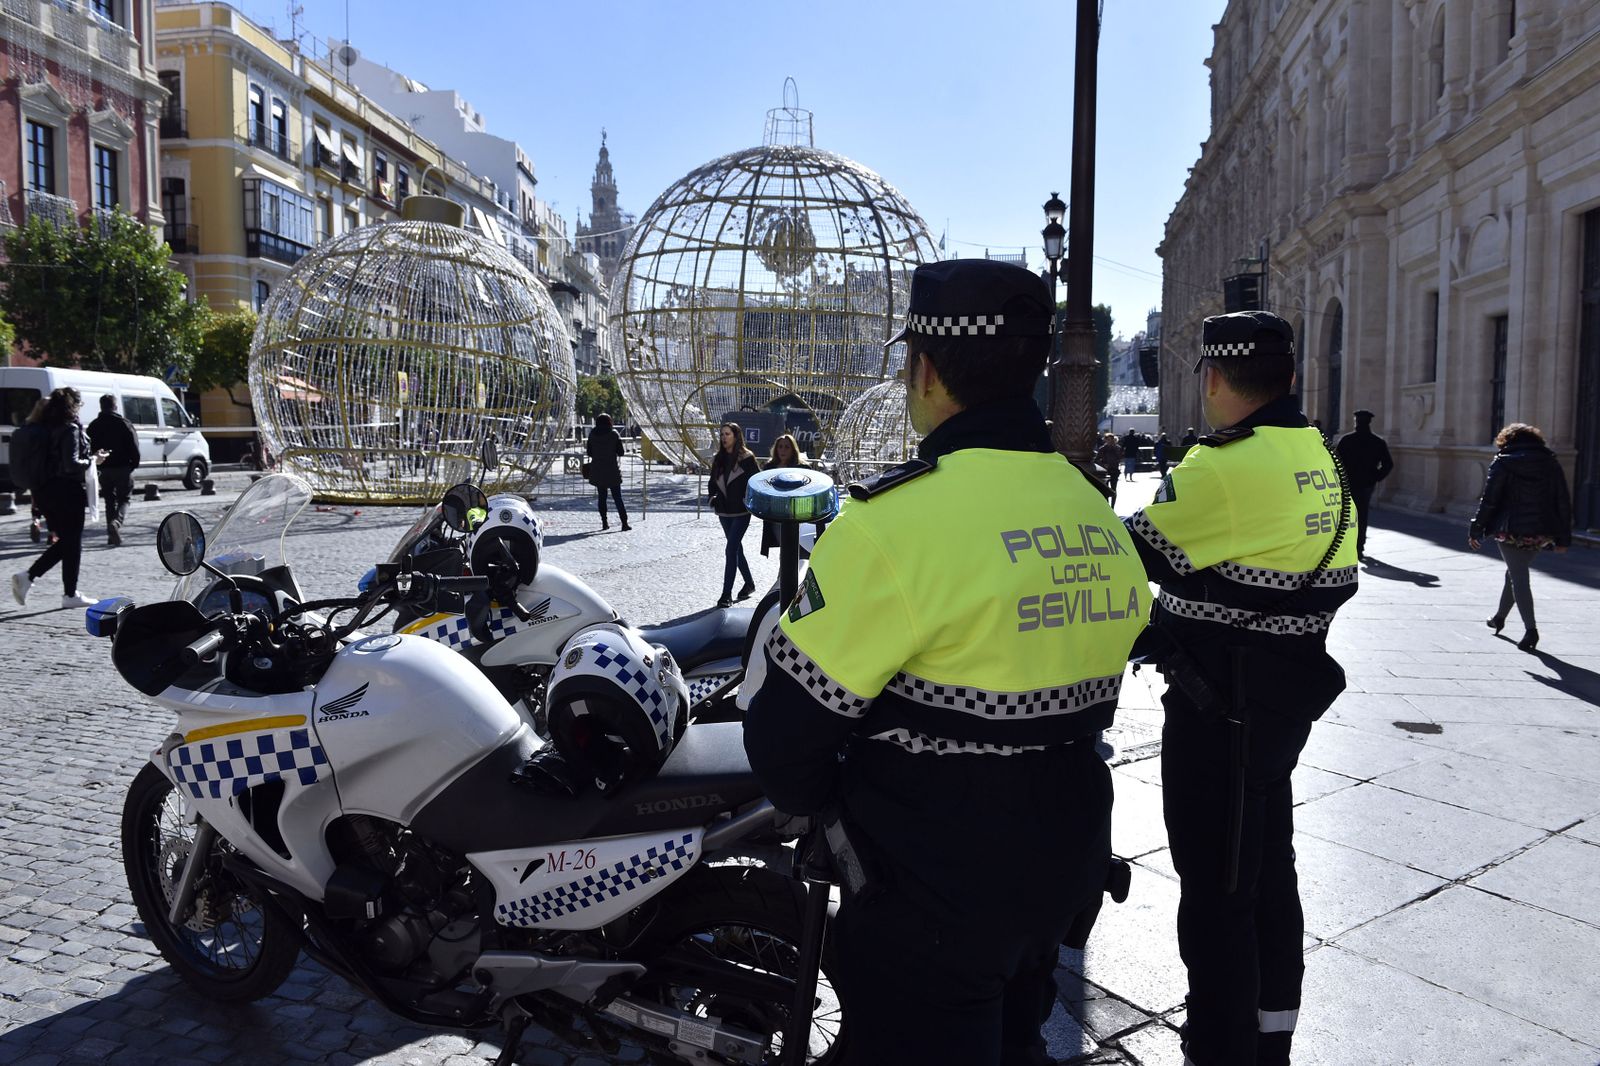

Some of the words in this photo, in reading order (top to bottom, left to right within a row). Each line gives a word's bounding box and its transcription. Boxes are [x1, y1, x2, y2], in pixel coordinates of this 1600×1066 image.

[1294, 469, 1341, 494] POLI
[1322, 493, 1342, 506] LOC
[1000, 524, 1129, 563] POLICIA
[1051, 562, 1111, 585] LOCAL
[527, 614, 560, 627] HONDA
[1017, 586, 1140, 632] SEVILLA
[317, 710, 370, 723] HONDA
[633, 793, 727, 816] HONDA
[546, 847, 598, 874] M-26
